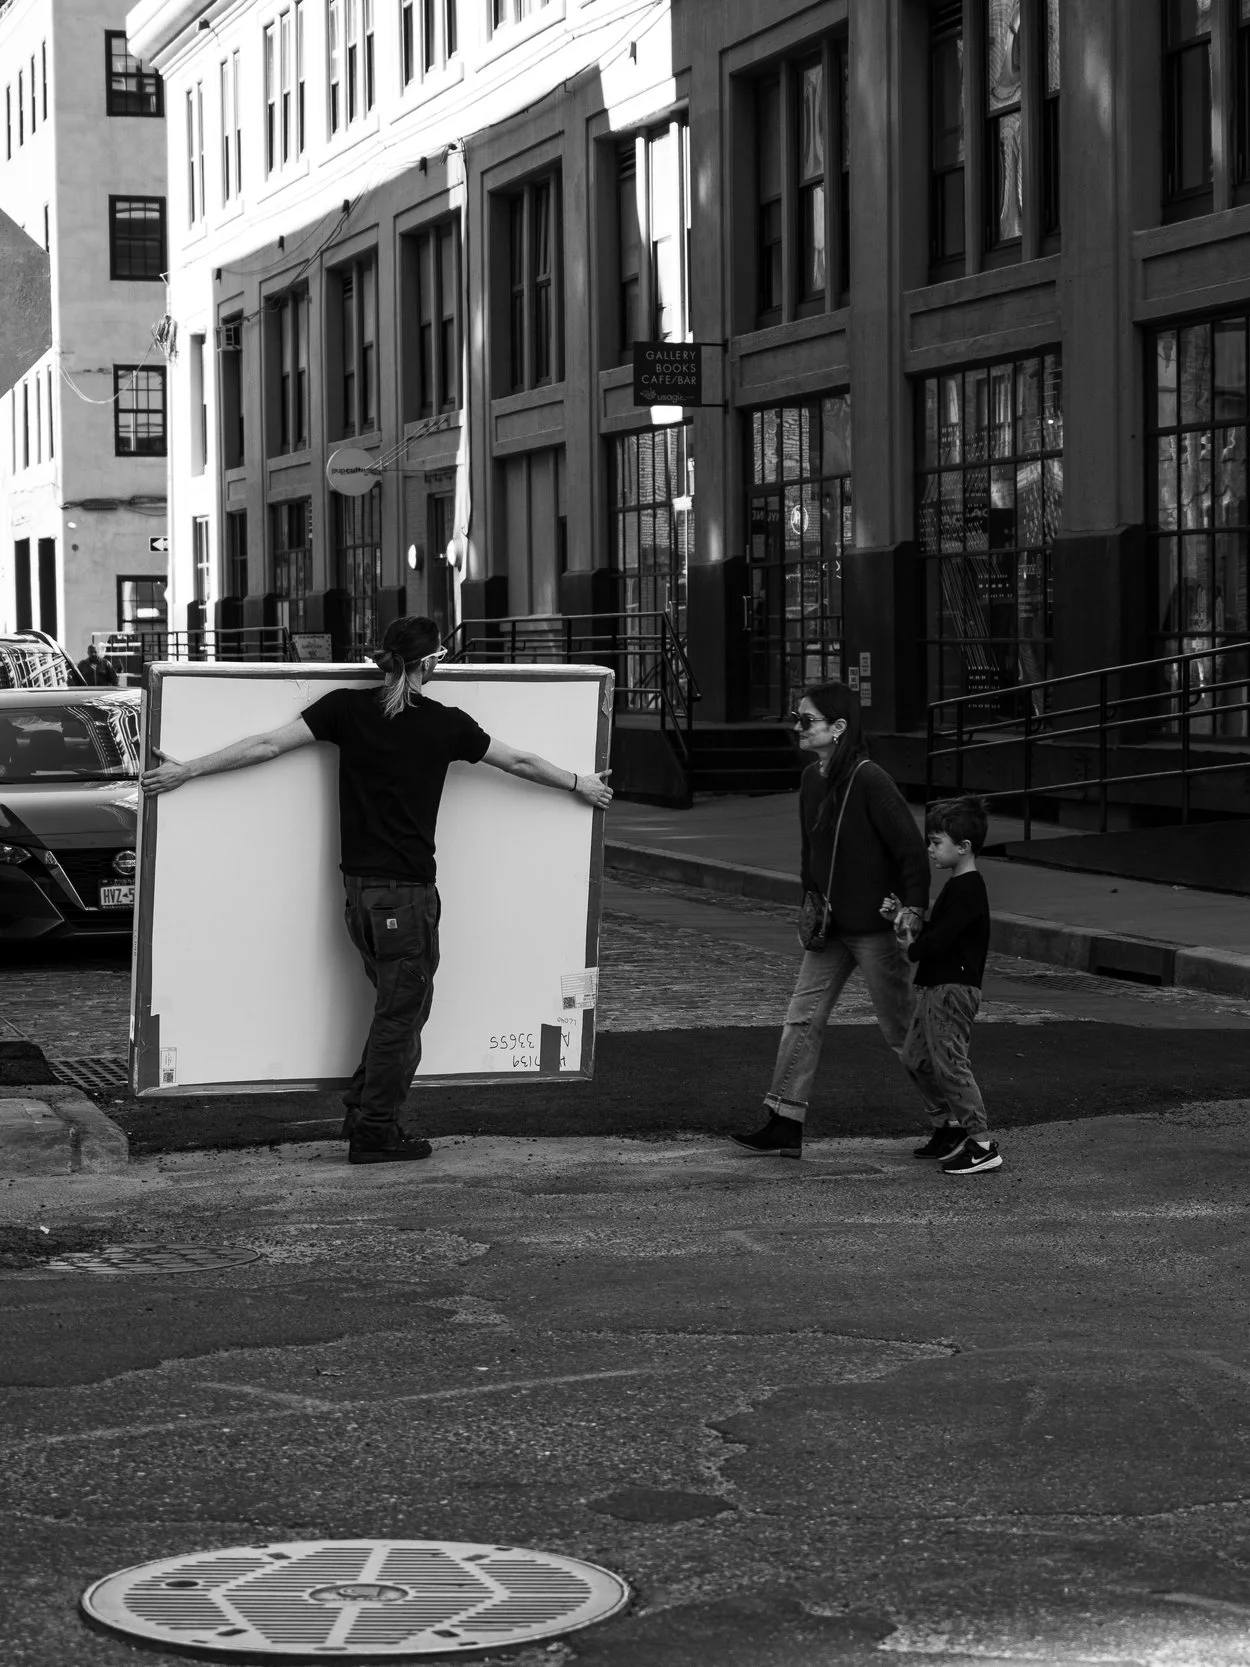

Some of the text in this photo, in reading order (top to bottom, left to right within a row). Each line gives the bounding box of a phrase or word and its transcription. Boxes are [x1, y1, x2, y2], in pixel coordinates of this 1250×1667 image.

[645, 350, 697, 360] GALLERY
[655, 363, 697, 373] BOOKS
[641, 374, 697, 385] CAFE/BAR
[103, 888, 123, 903] HVZ
[489, 1033, 535, 1050] 33655
